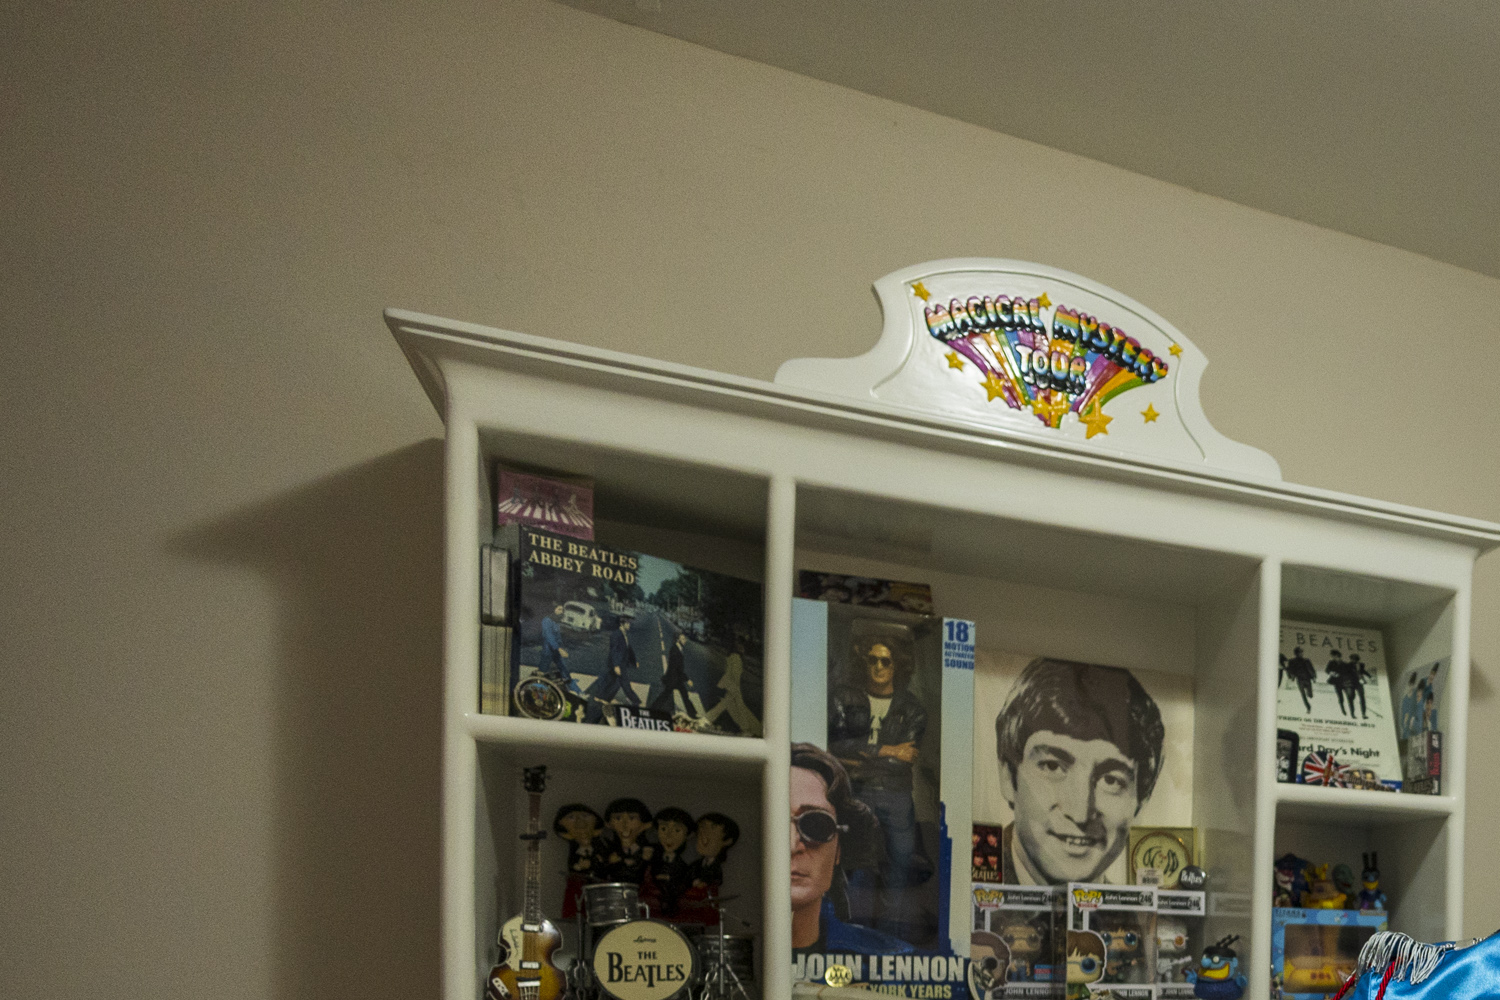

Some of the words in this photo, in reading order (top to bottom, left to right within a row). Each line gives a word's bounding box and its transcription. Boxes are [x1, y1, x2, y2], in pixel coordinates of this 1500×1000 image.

[924, 295, 1048, 342] MAGICAL
[1050, 305, 1169, 383] MYSTERY
[1015, 344, 1086, 396] TOUR
[528, 533, 562, 551] THE
[567, 543, 638, 571] BEATLES
[528, 550, 584, 574] ABBEY
[592, 562, 636, 585] ROAD
[945, 621, 969, 643] 18
[1296, 632, 1378, 653] BEATLES
[944, 659, 975, 670] SOUND
[620, 707, 671, 733] BEATLES
[1350, 747, 1381, 759] Night
[638, 951, 657, 960] THE
[607, 952, 686, 987] BEATLES
[869, 955, 965, 983] LENNON
[909, 984, 952, 999] YEARS
